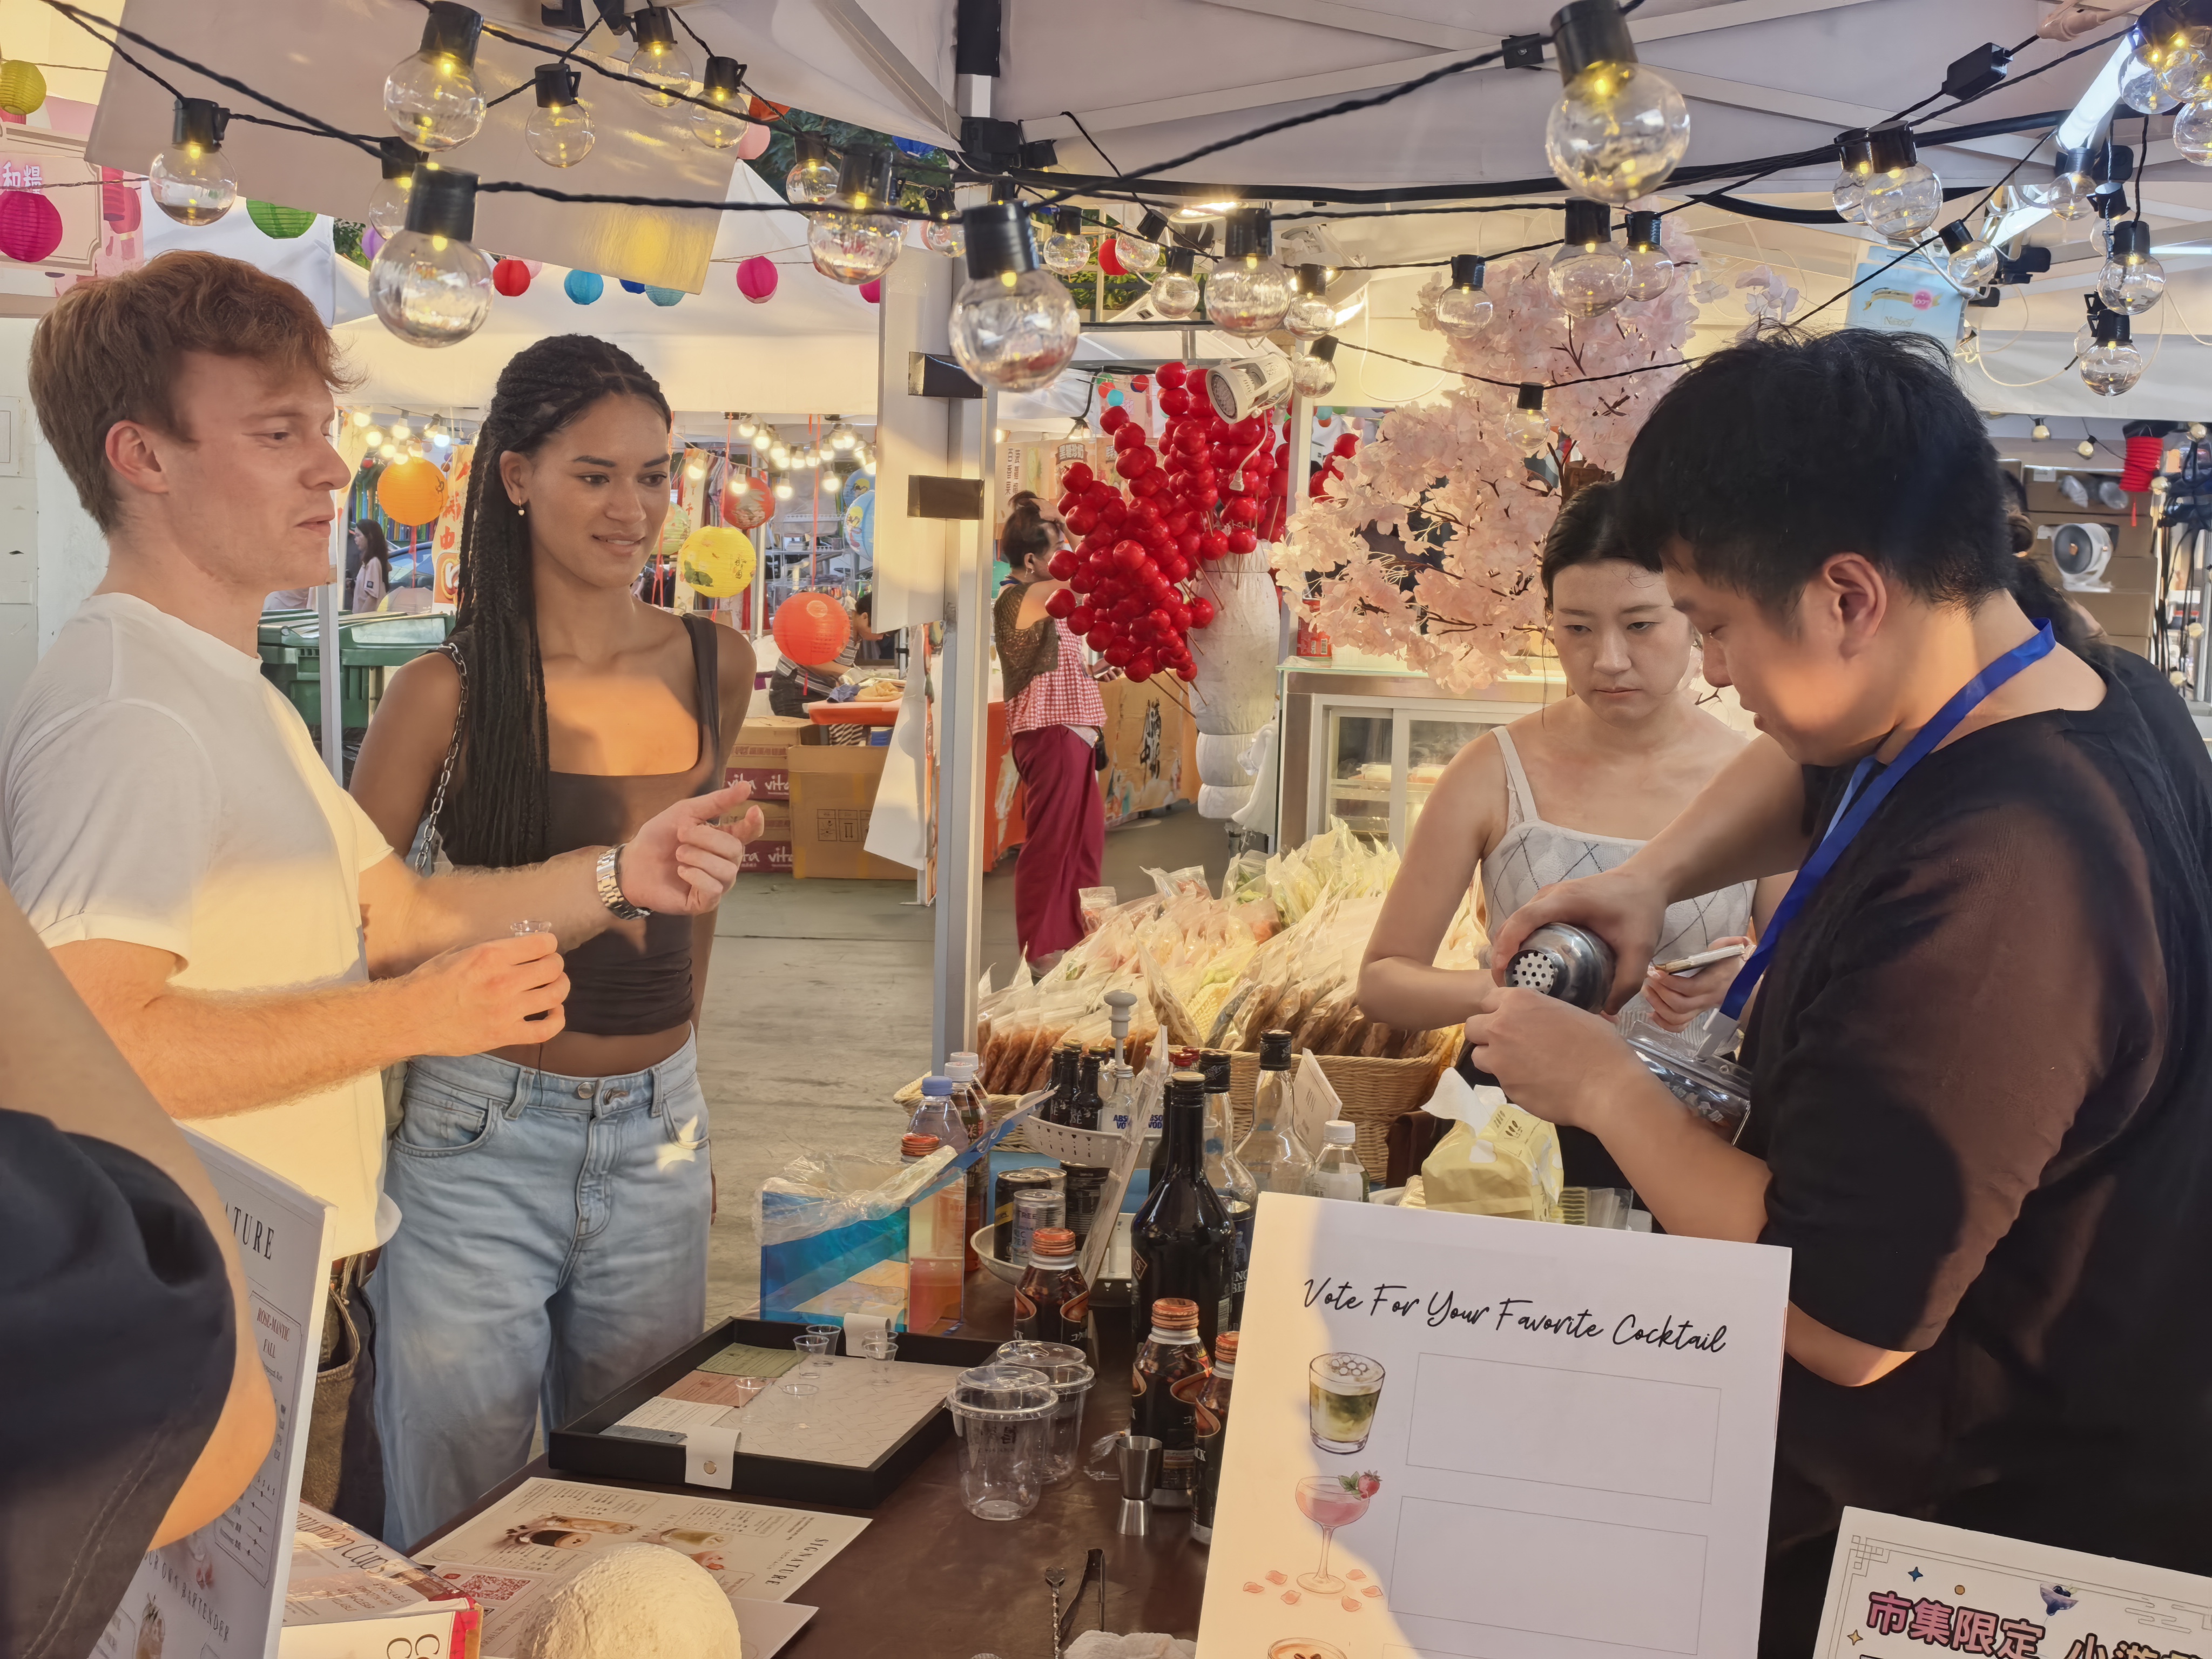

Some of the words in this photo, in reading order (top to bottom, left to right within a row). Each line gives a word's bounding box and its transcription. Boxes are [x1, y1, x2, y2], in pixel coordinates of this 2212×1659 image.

[1112, 1114, 1129, 1122] ABS
[1304, 1277, 1363, 1310] Vote
[1368, 1283, 1420, 1317] For
[1427, 1291, 1490, 1327] Your
[1495, 1298, 1604, 1338] Favorite
[1613, 1313, 1727, 1353] Cocktail
[1867, 1590, 2046, 1659] 市集限定
